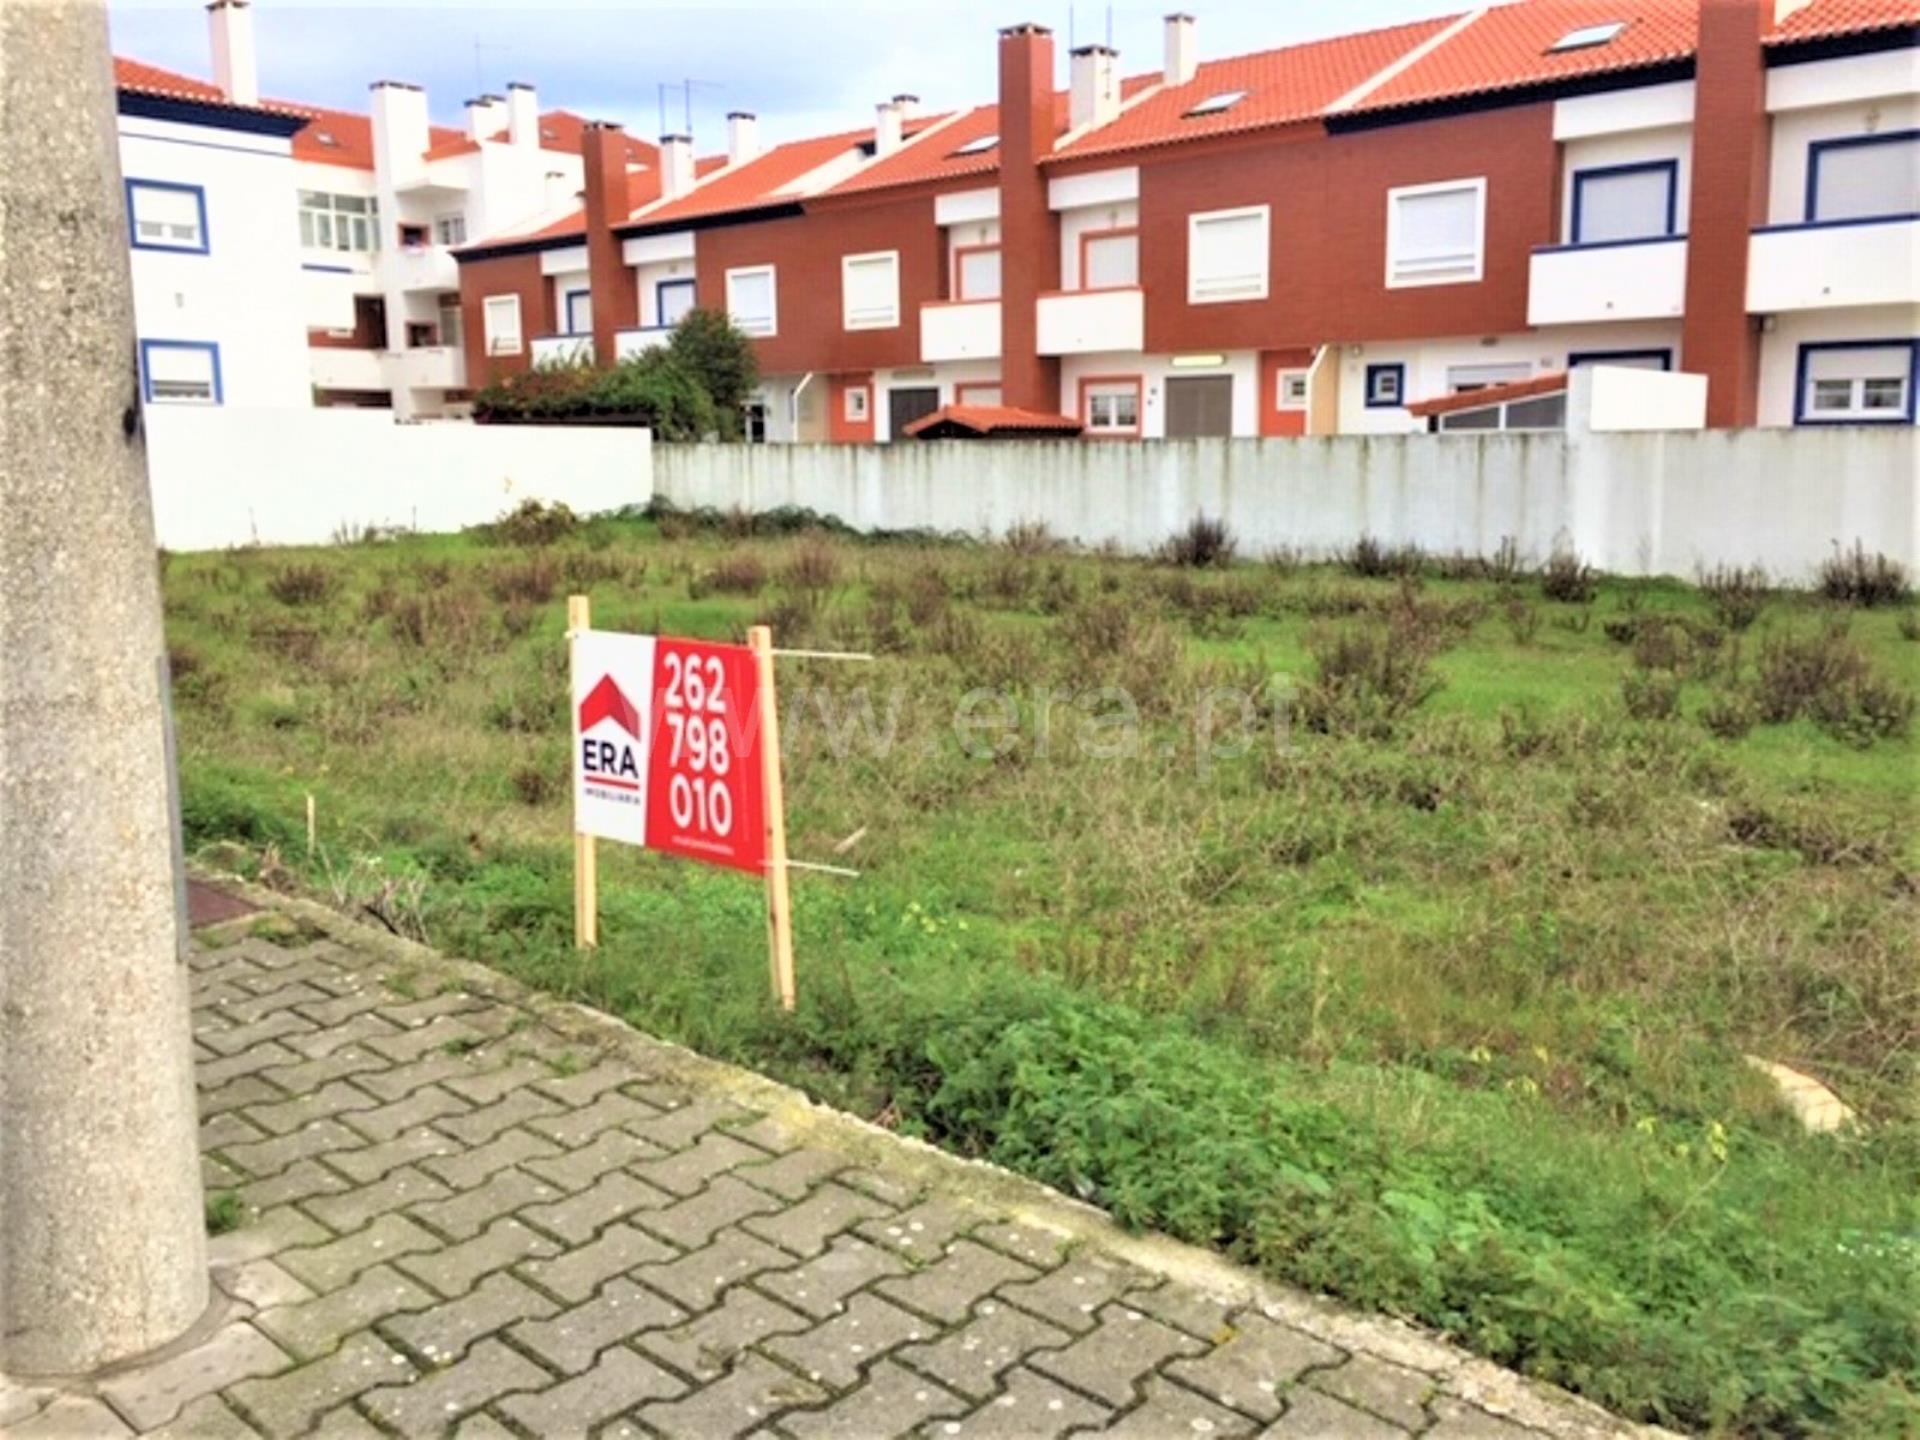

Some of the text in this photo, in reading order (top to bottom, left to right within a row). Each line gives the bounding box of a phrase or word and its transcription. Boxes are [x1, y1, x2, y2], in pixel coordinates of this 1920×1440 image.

[664, 652, 726, 713] 262
[583, 739, 639, 778] ERA
[666, 712, 730, 775] 798
[671, 773, 732, 836] 010
